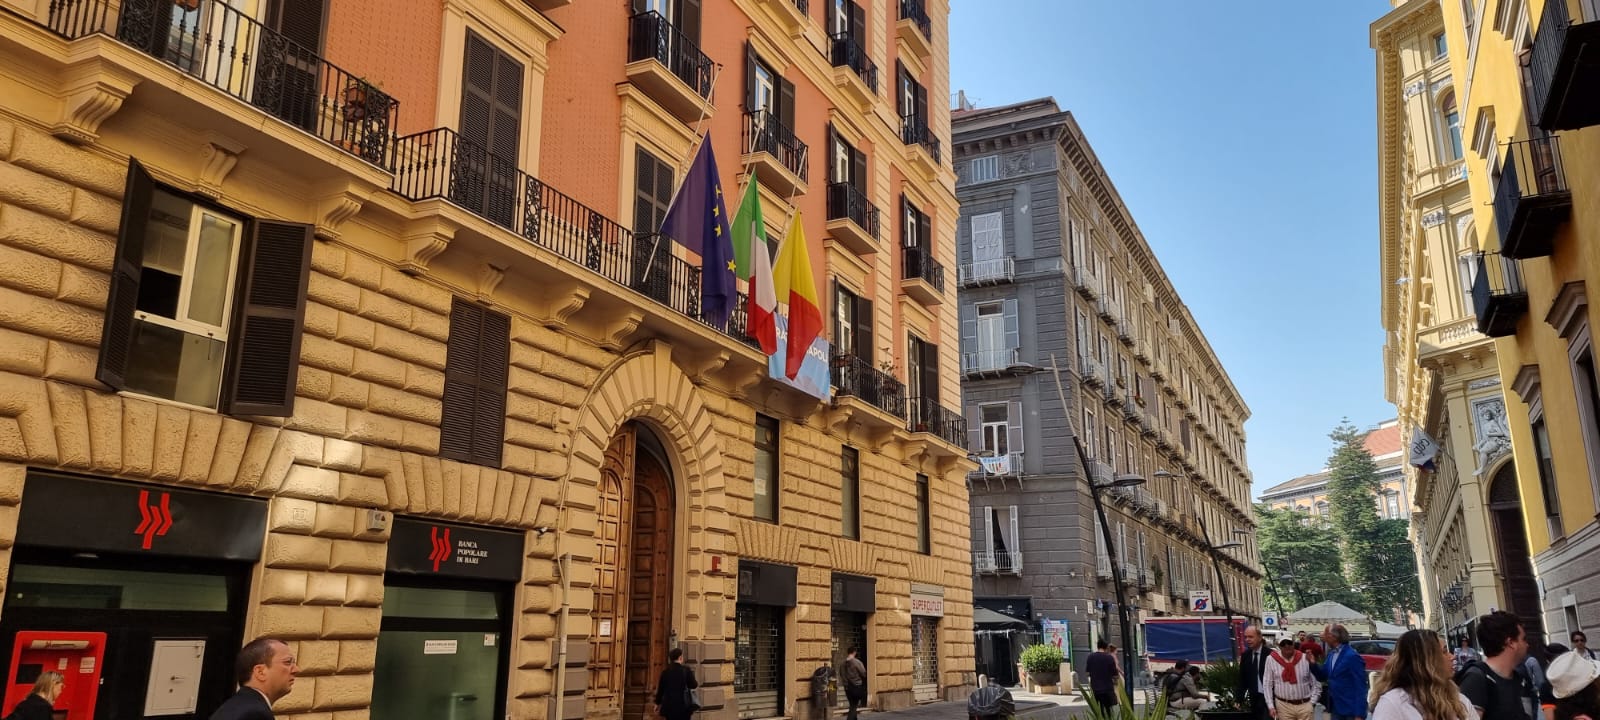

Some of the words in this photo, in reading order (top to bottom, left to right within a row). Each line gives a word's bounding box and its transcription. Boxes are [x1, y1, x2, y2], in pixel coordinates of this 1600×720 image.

[806, 345, 828, 362] APOLI
[458, 540, 478, 549] BANCA
[457, 548, 488, 558] POPOLARE
[464, 556, 479, 564] BARI
